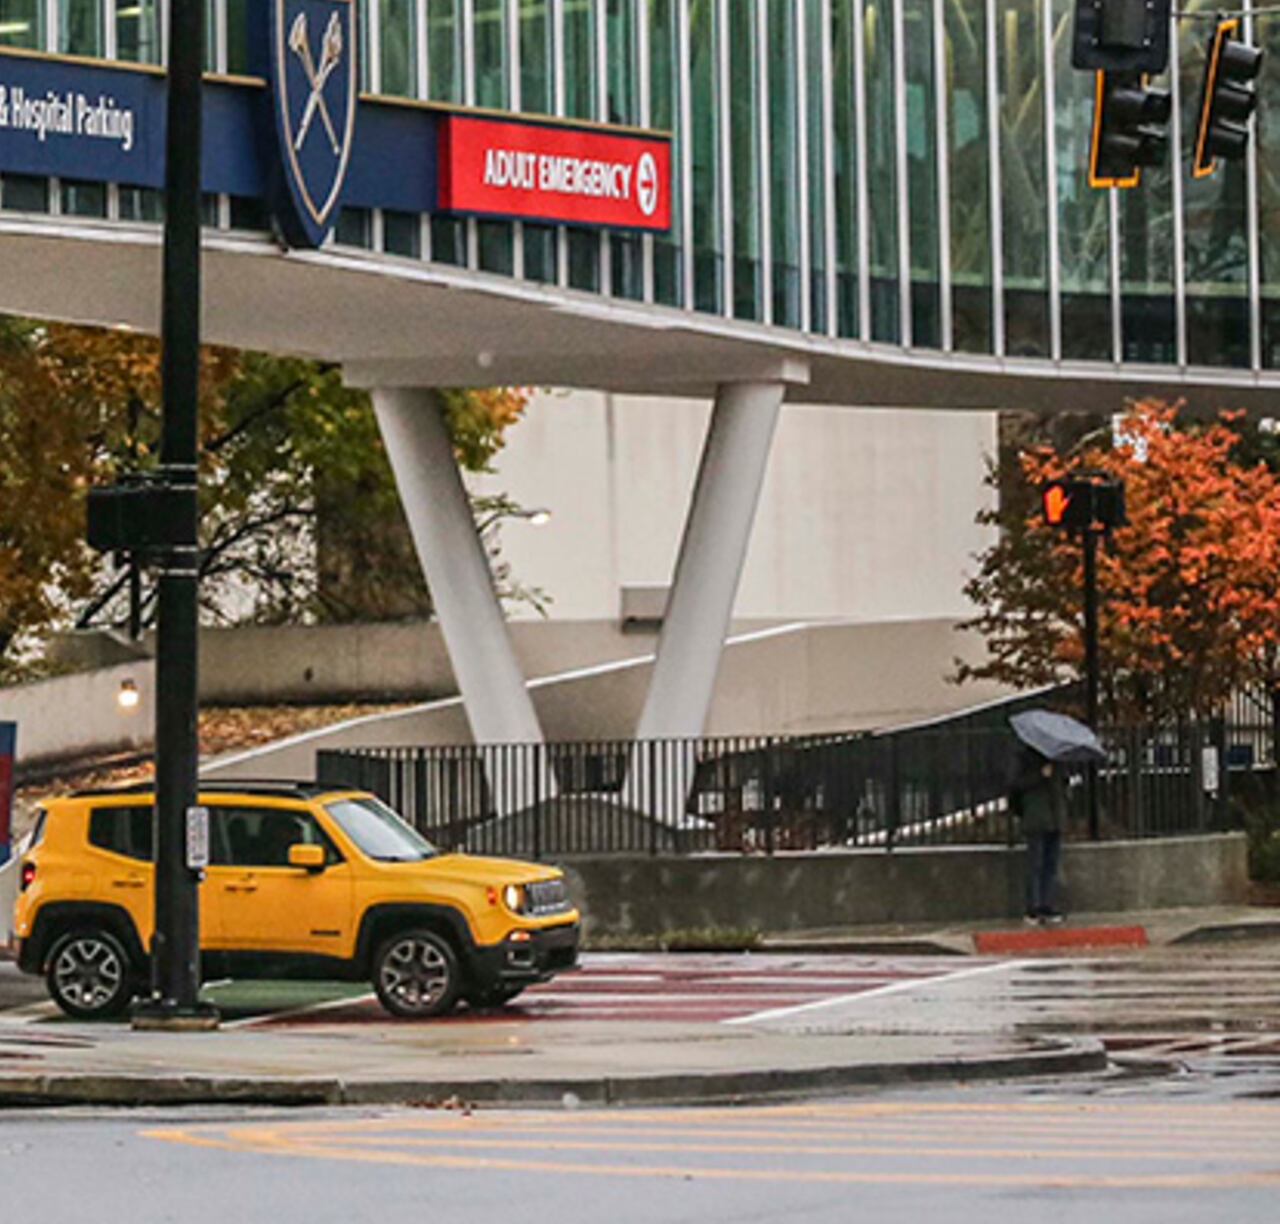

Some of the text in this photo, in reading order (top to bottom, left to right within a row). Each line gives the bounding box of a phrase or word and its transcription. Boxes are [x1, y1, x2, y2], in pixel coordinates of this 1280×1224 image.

[11, 86, 73, 141] Hospital
[76, 93, 134, 151] Parking
[483, 148, 633, 199] ADULT EMERGENCY
